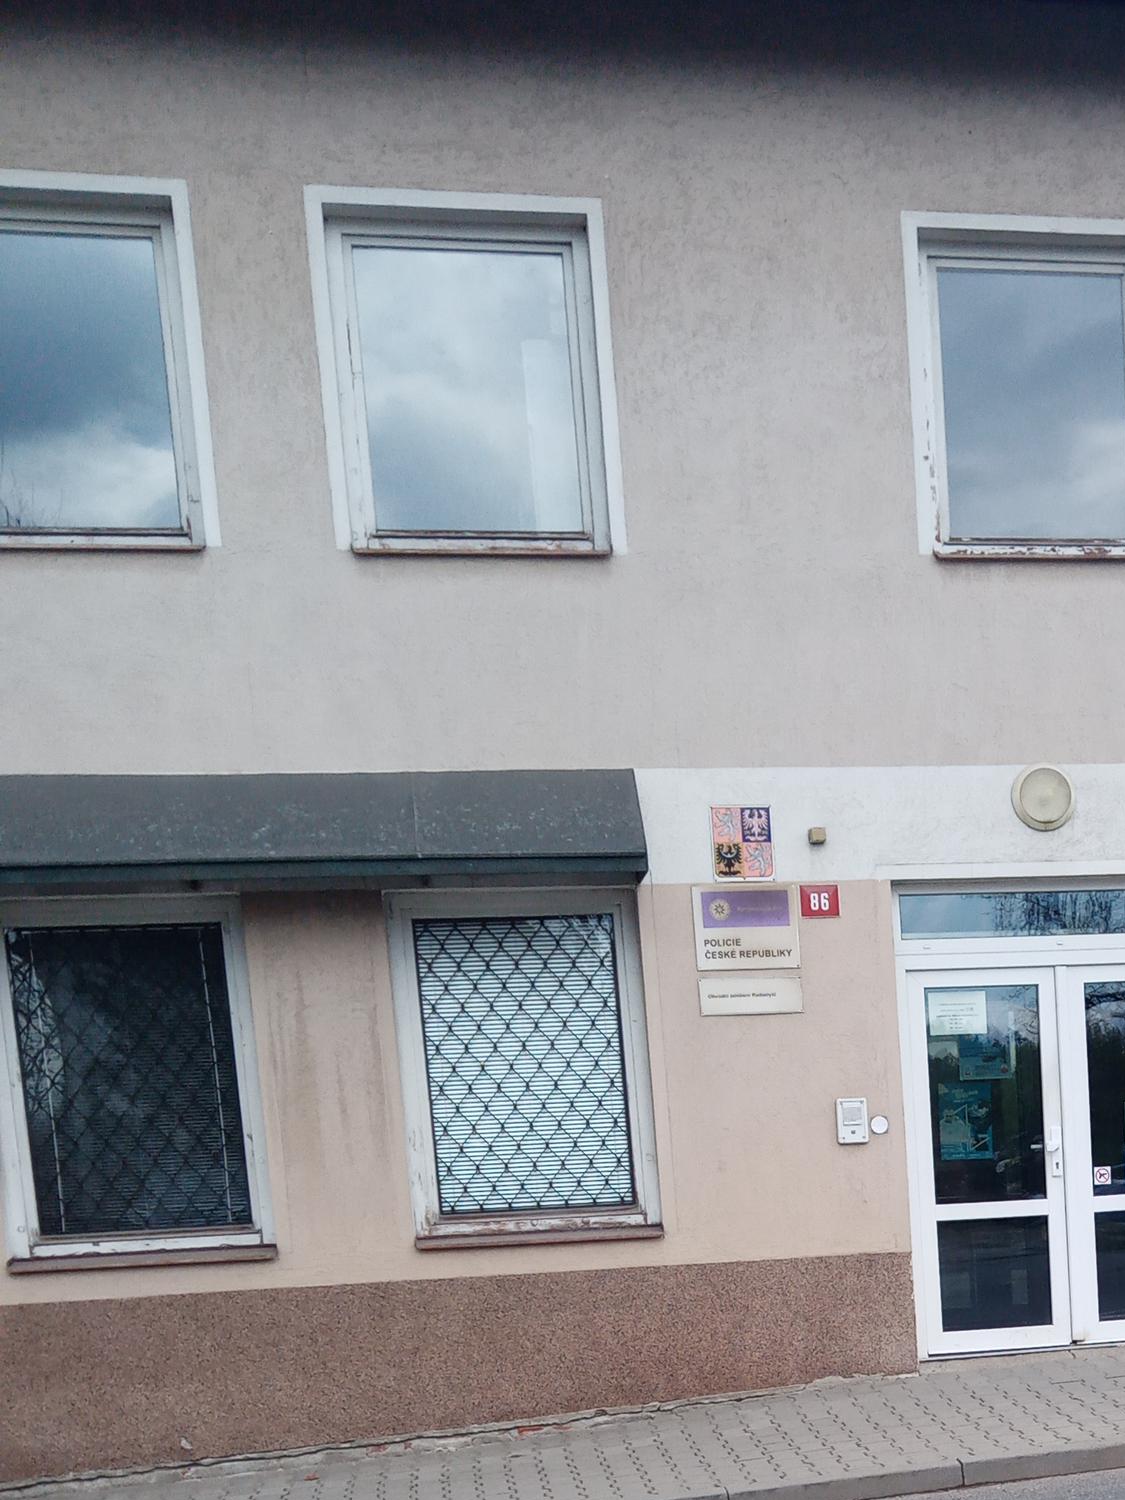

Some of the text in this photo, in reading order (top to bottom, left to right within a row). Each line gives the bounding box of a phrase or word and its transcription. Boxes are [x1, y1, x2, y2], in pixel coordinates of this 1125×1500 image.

[810, 893, 830, 911] 86
[704, 938, 742, 947] POLICIE
[704, 949, 792, 959] ČESKÉ REPUBLIKY
